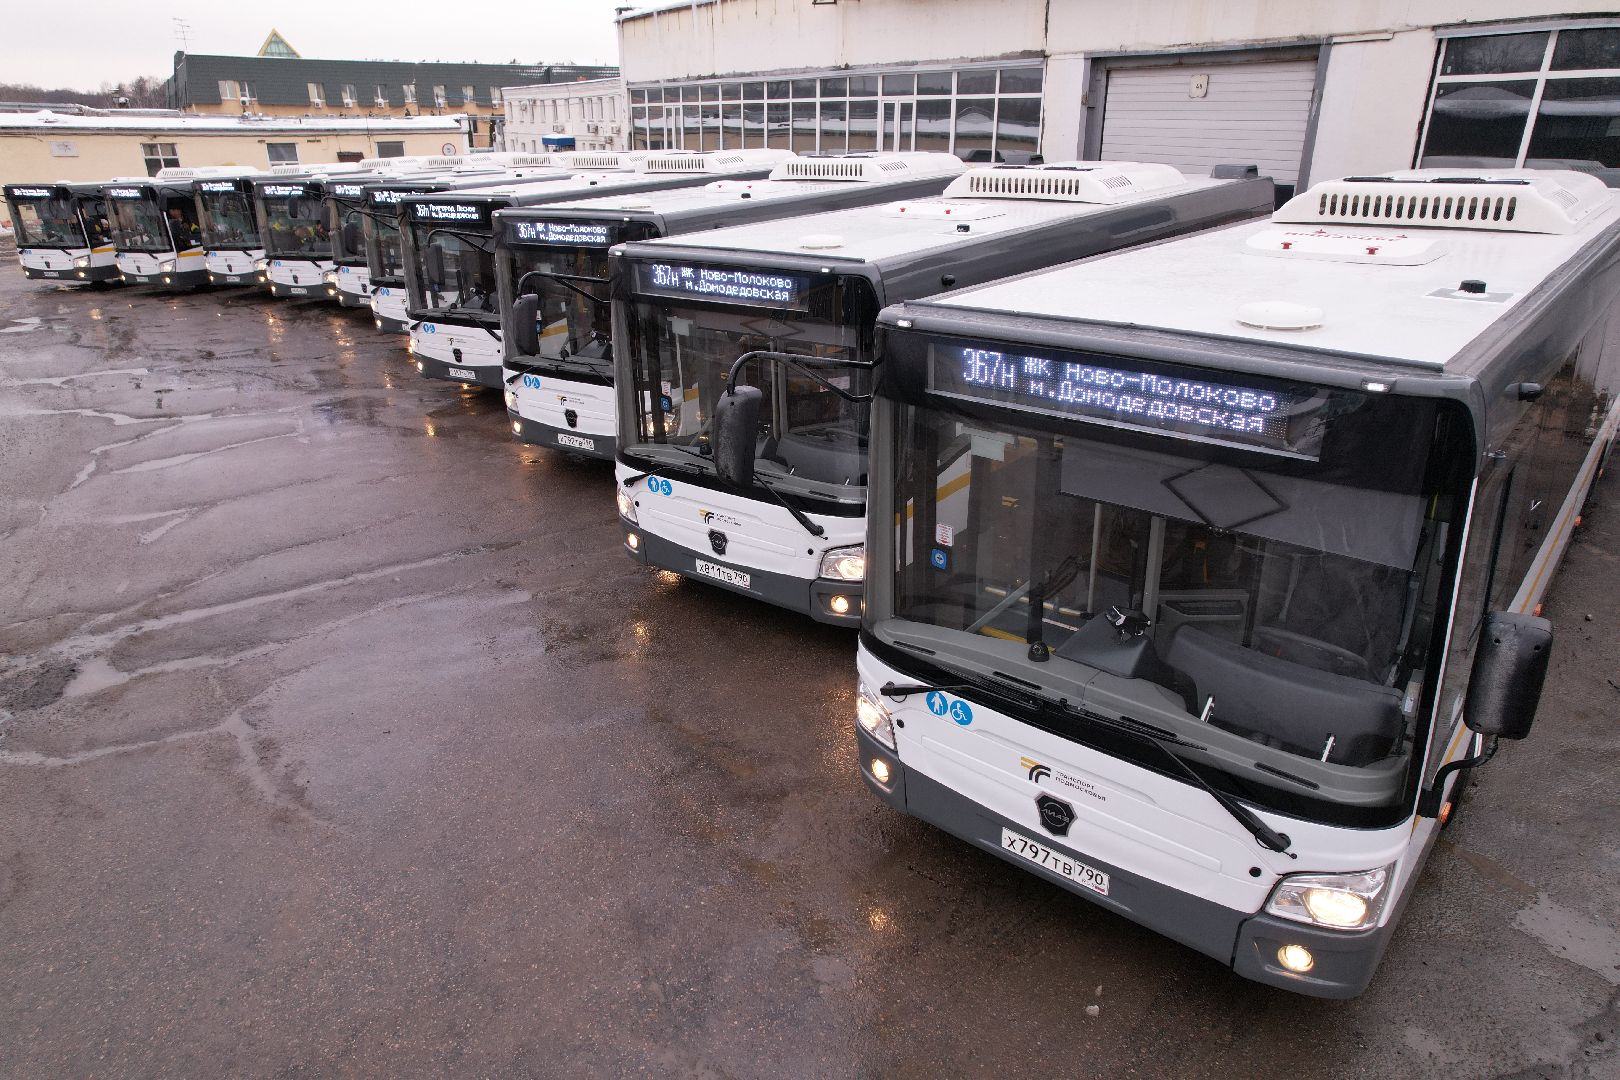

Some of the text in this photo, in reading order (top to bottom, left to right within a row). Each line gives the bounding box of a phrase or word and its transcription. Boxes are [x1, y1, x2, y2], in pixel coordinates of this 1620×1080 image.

[548, 224, 607, 234] Ново-Молоково
[652, 264, 679, 287] 367н
[681, 266, 792, 289] ЖК Ново-Молоково
[963, 348, 1015, 389] 367н
[1023, 356, 1277, 412] ЖК Ново-Молоково
[1055, 776, 1106, 802] ПОДМОСКОВЬЯ
[1056, 770, 1095, 790] ТРАНСПОРТ
[1077, 863, 1104, 886] 790
